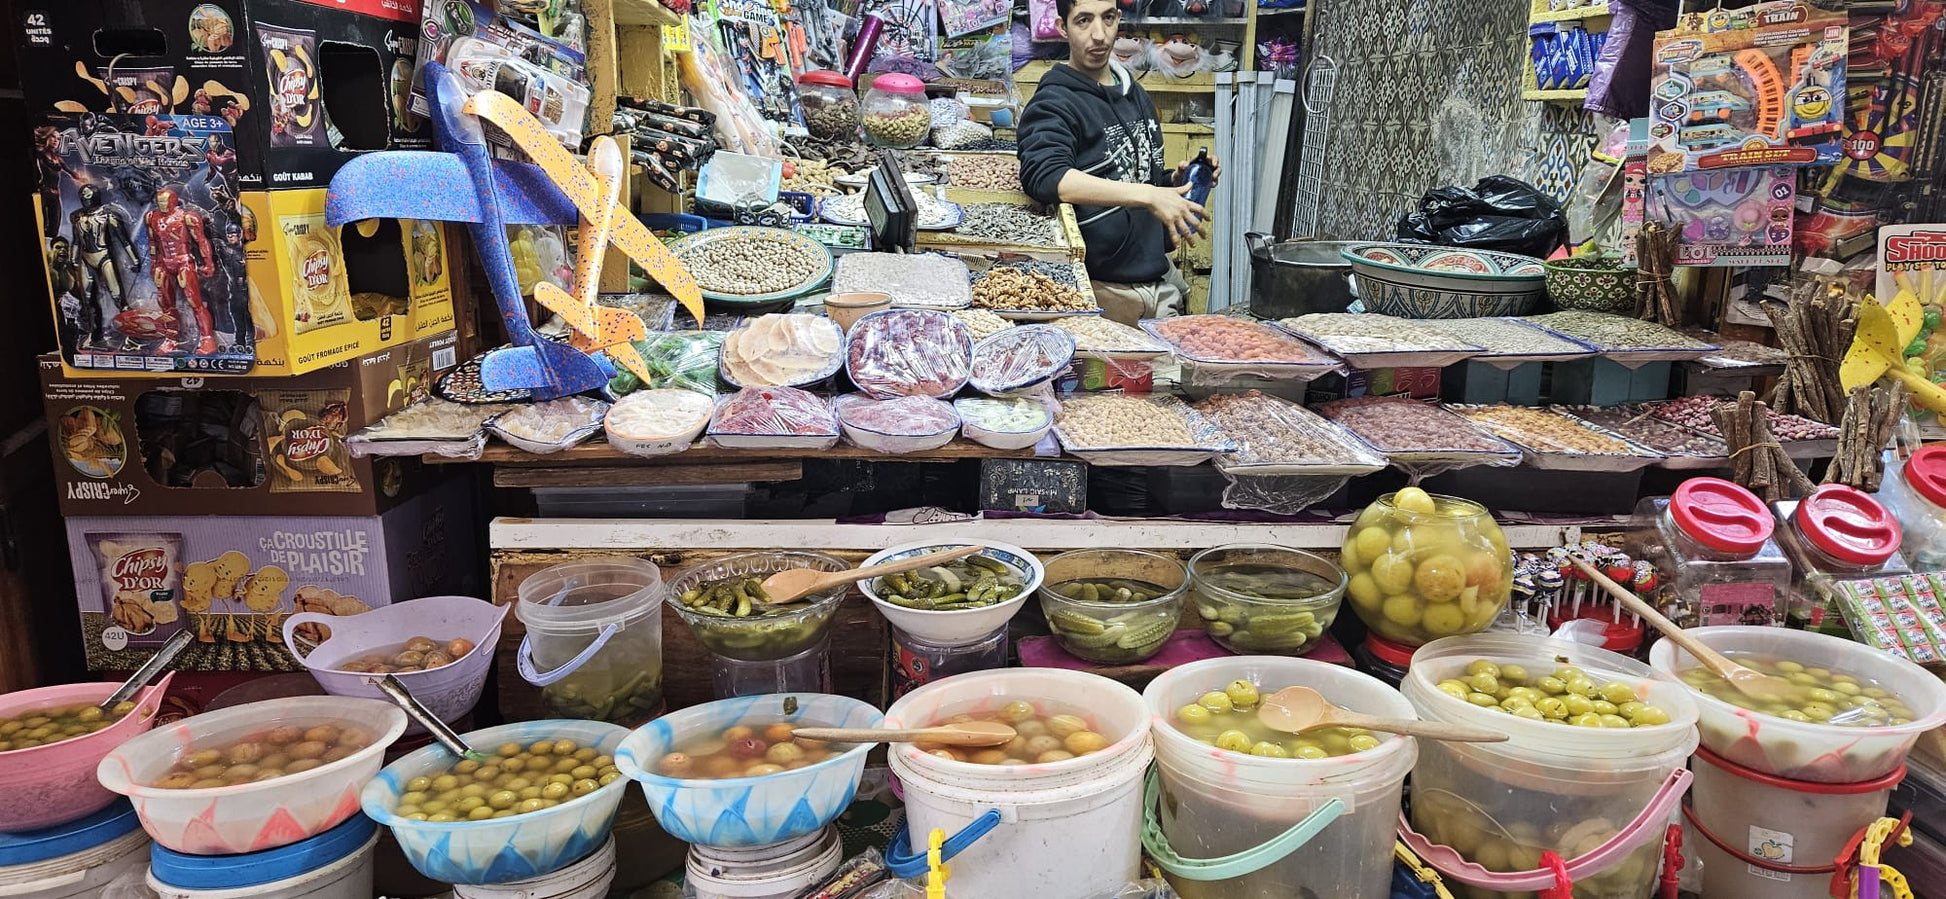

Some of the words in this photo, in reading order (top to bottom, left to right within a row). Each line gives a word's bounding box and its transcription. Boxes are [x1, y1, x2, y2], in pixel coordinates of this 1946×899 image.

[27, 14, 46, 26] 42
[743, 11, 769, 23] GAME
[1764, 11, 1799, 24] TRAIN
[280, 73, 306, 94] Chipsy
[182, 118, 207, 128] AGE
[210, 118, 223, 128] 3+
[59, 127, 206, 164] AVENGERS
[1852, 140, 1875, 151] 100
[1720, 150, 1763, 161] TRAIN
[1764, 149, 1791, 158] SET
[273, 171, 291, 182] GOÛT
[292, 171, 314, 181] KABAB
[1774, 186, 1789, 198] 01
[1679, 244, 1717, 260] LOL
[302, 255, 329, 277] Chipsy
[1886, 262, 1911, 272] PLAY
[308, 274, 328, 287] D'OR
[381, 318, 390, 327] 42
[298, 353, 315, 364] GOÛT
[316, 346, 343, 360] FROMAGE
[291, 429, 321, 439] D'OR
[286, 437, 329, 456] Chipsy
[67, 481, 110, 500] CRISPY
[273, 529, 369, 553] CROUSTILLE
[112, 553, 167, 577] Chipsy
[270, 550, 287, 563] DE
[286, 550, 365, 576] PLAISIR
[122, 576, 164, 590] D'OR
[104, 631, 125, 640] 42U
